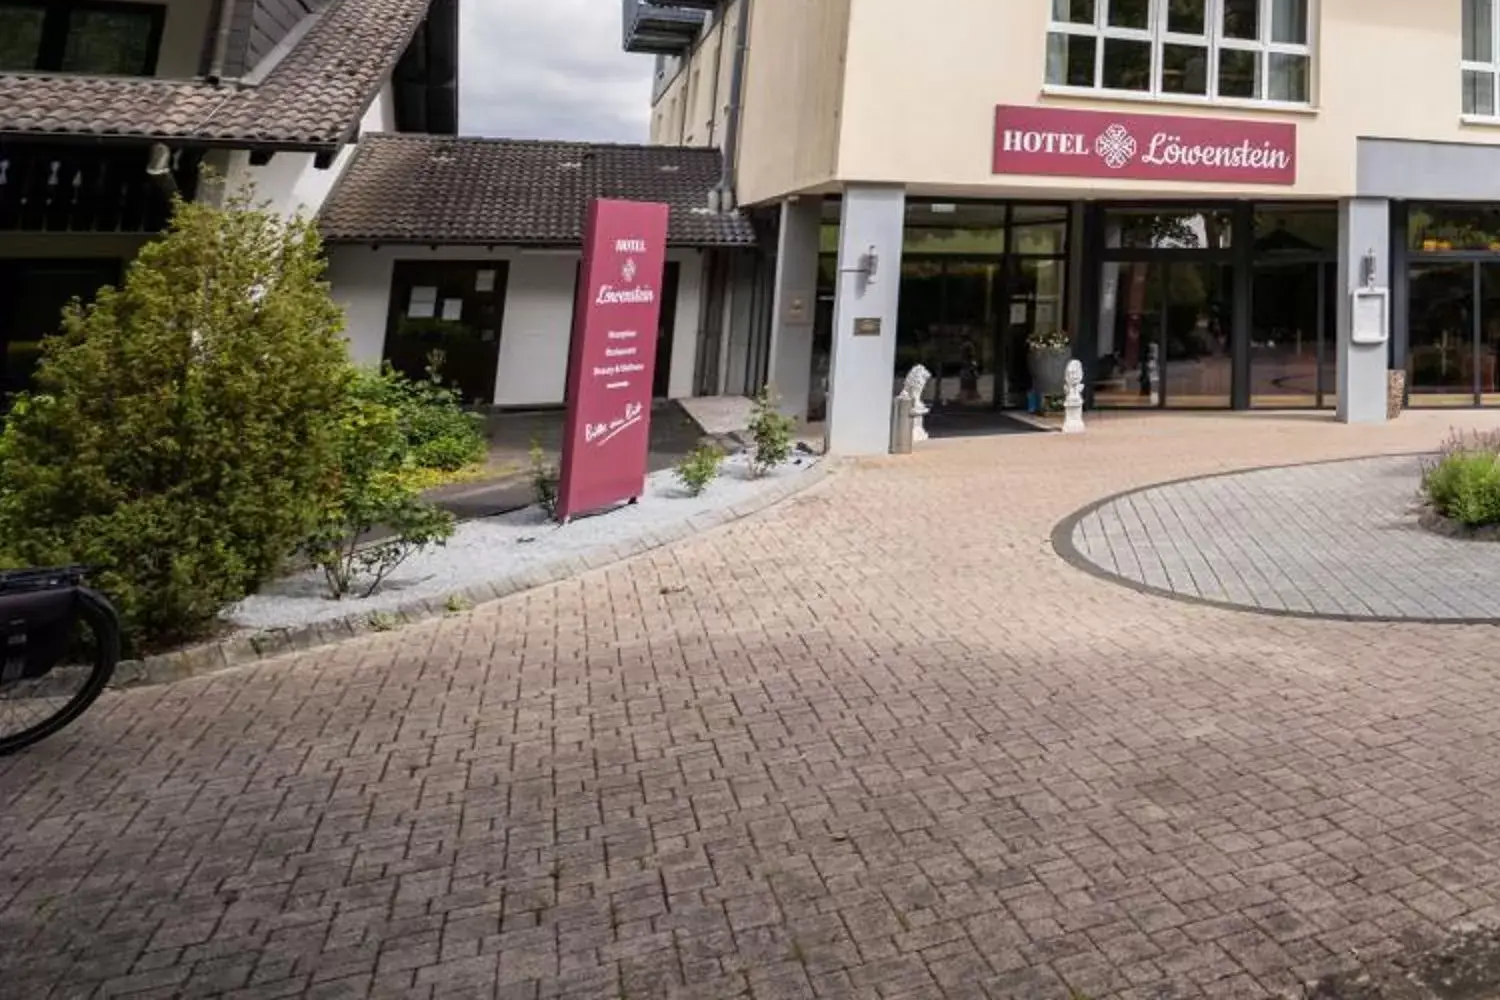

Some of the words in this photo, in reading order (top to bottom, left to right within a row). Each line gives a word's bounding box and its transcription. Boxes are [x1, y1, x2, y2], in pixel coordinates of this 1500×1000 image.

[1003, 130, 1088, 155] HOTEL
[1141, 132, 1290, 169] Löwenstein
[616, 239, 646, 252] HOTEL
